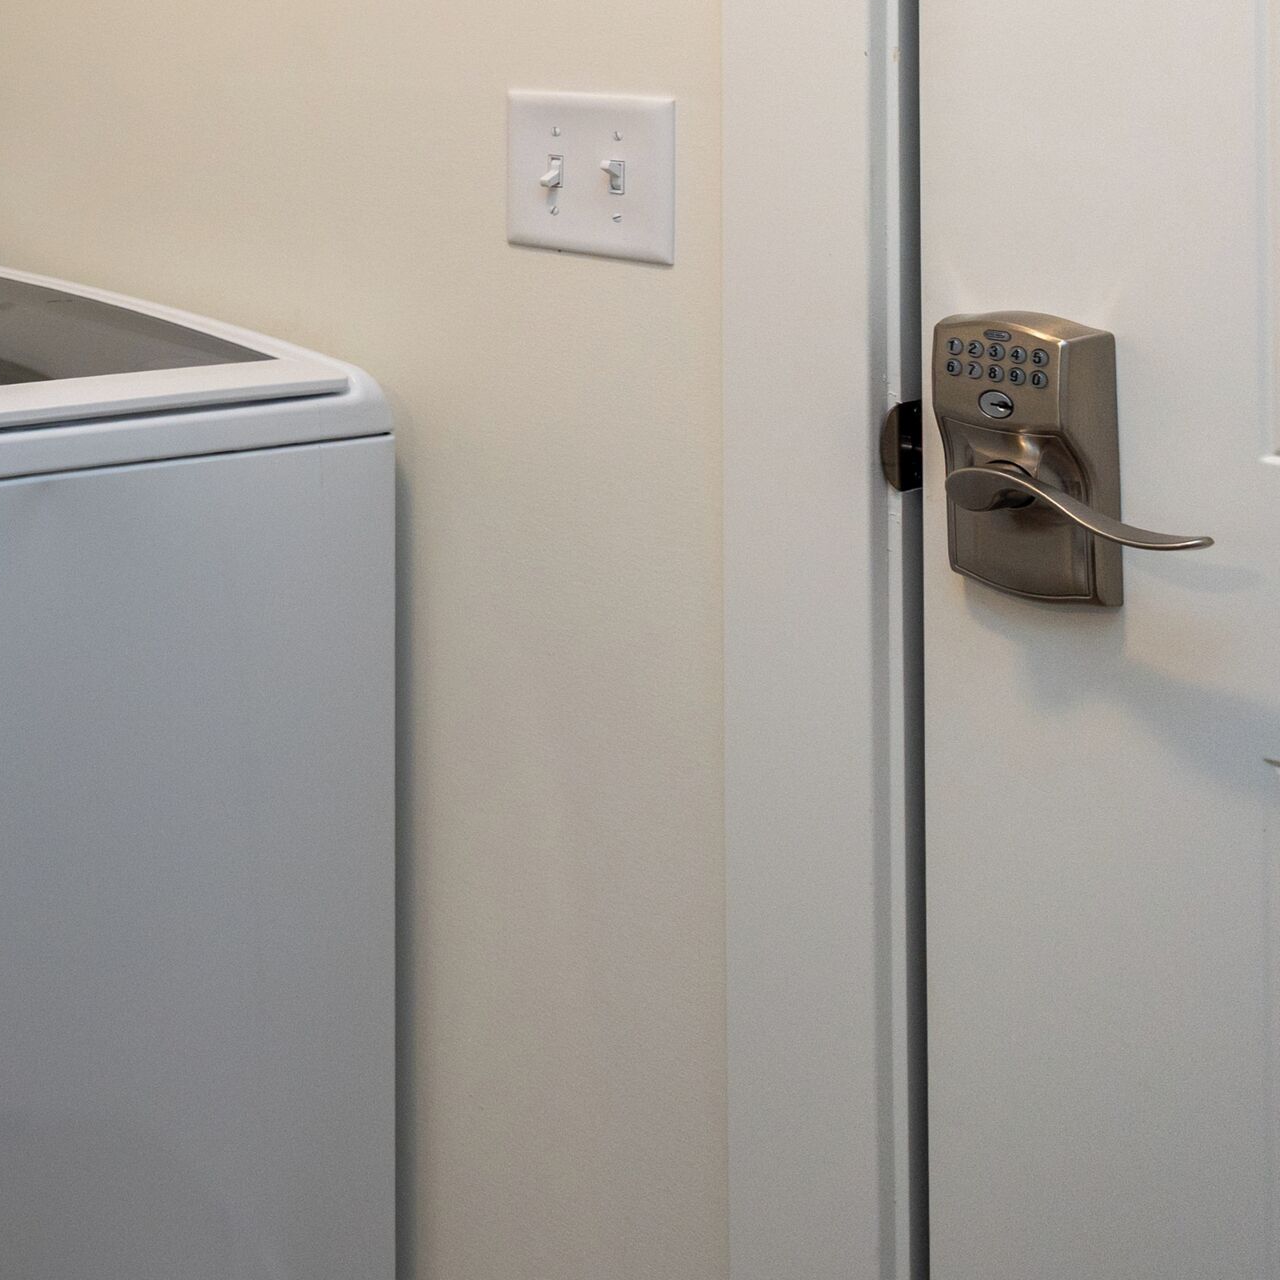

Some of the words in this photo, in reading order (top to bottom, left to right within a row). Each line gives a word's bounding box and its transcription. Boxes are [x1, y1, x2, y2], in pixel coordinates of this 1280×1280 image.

[948, 340, 955, 351] 1
[968, 342, 977, 355] 2
[989, 345, 998, 358] 3
[1011, 349, 1020, 361] 4
[1032, 352, 1042, 364] 5
[946, 361, 954, 373] 6
[968, 363, 976, 375] 7
[988, 367, 997, 379] 8
[1010, 370, 1019, 382] 9
[1032, 373, 1040, 386] 0
